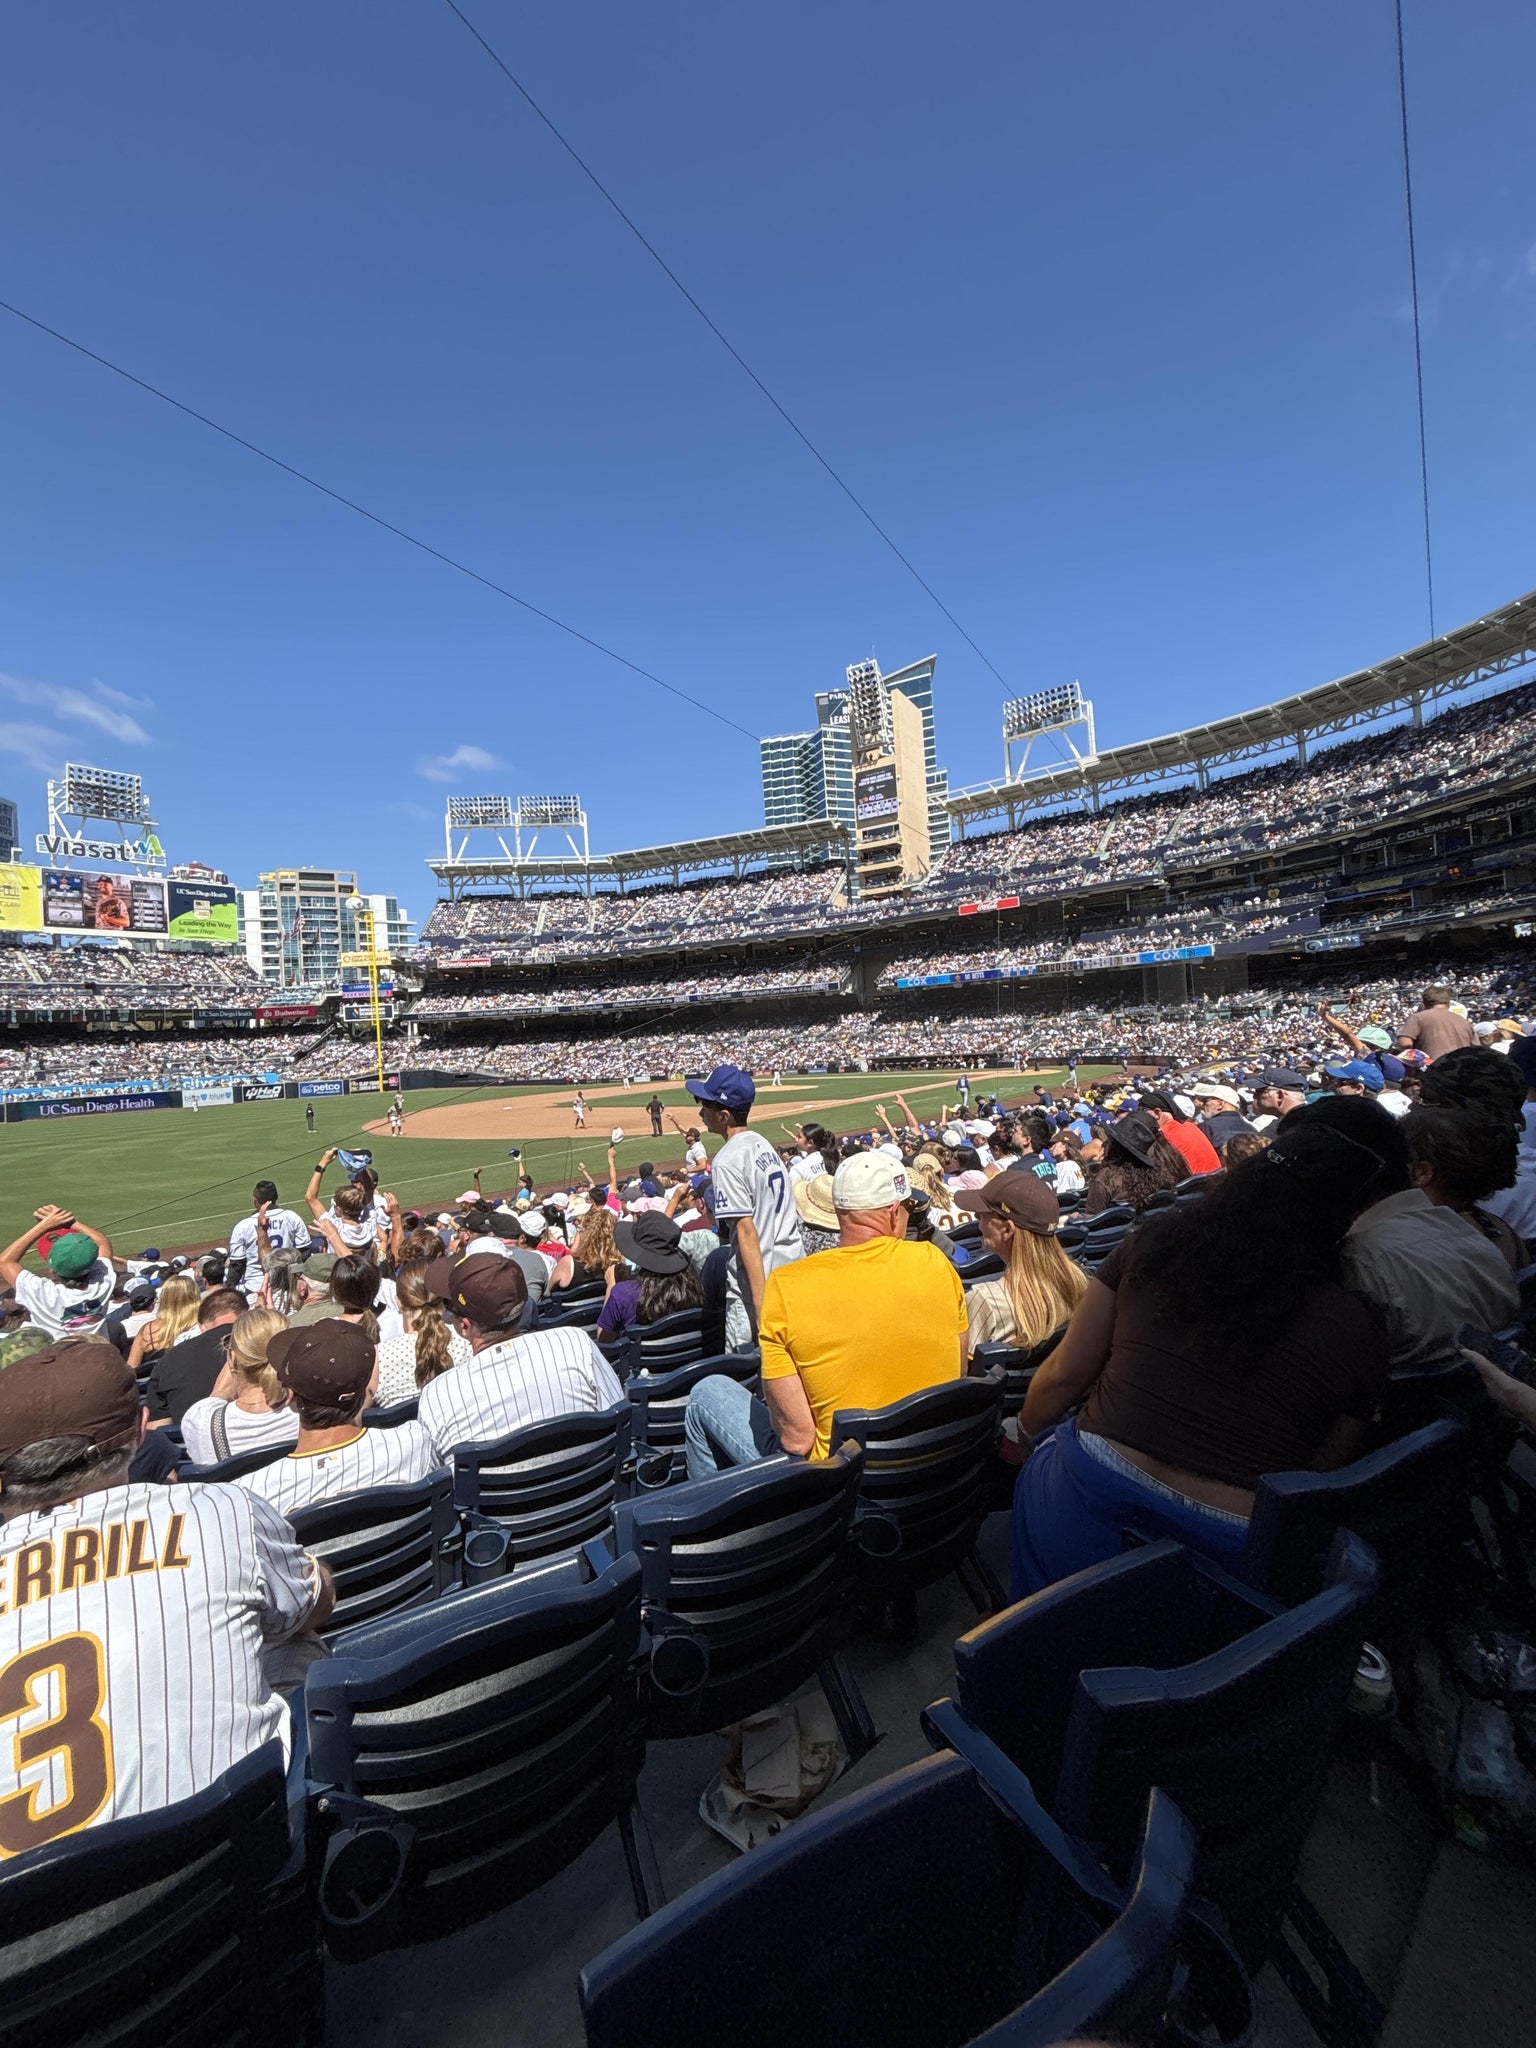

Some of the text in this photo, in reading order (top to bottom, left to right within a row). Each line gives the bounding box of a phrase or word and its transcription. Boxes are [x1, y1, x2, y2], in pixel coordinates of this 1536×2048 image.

[1353, 836, 1392, 851] JERRY
[1397, 817, 1462, 841] COLEMAN
[1465, 795, 1536, 822] BROADCA
[43, 834, 130, 861] Viasat
[197, 890, 211, 898] Diego
[179, 920, 205, 928] Leading
[206, 920, 217, 928] the
[1154, 950, 1180, 961] COX
[907, 976, 927, 986] COX
[313, 1083, 340, 1093] petco
[40, 1098, 155, 1116] UC San Diego Health
[0, 1513, 192, 1617] RRILL
[0, 1631, 116, 1858] 3
